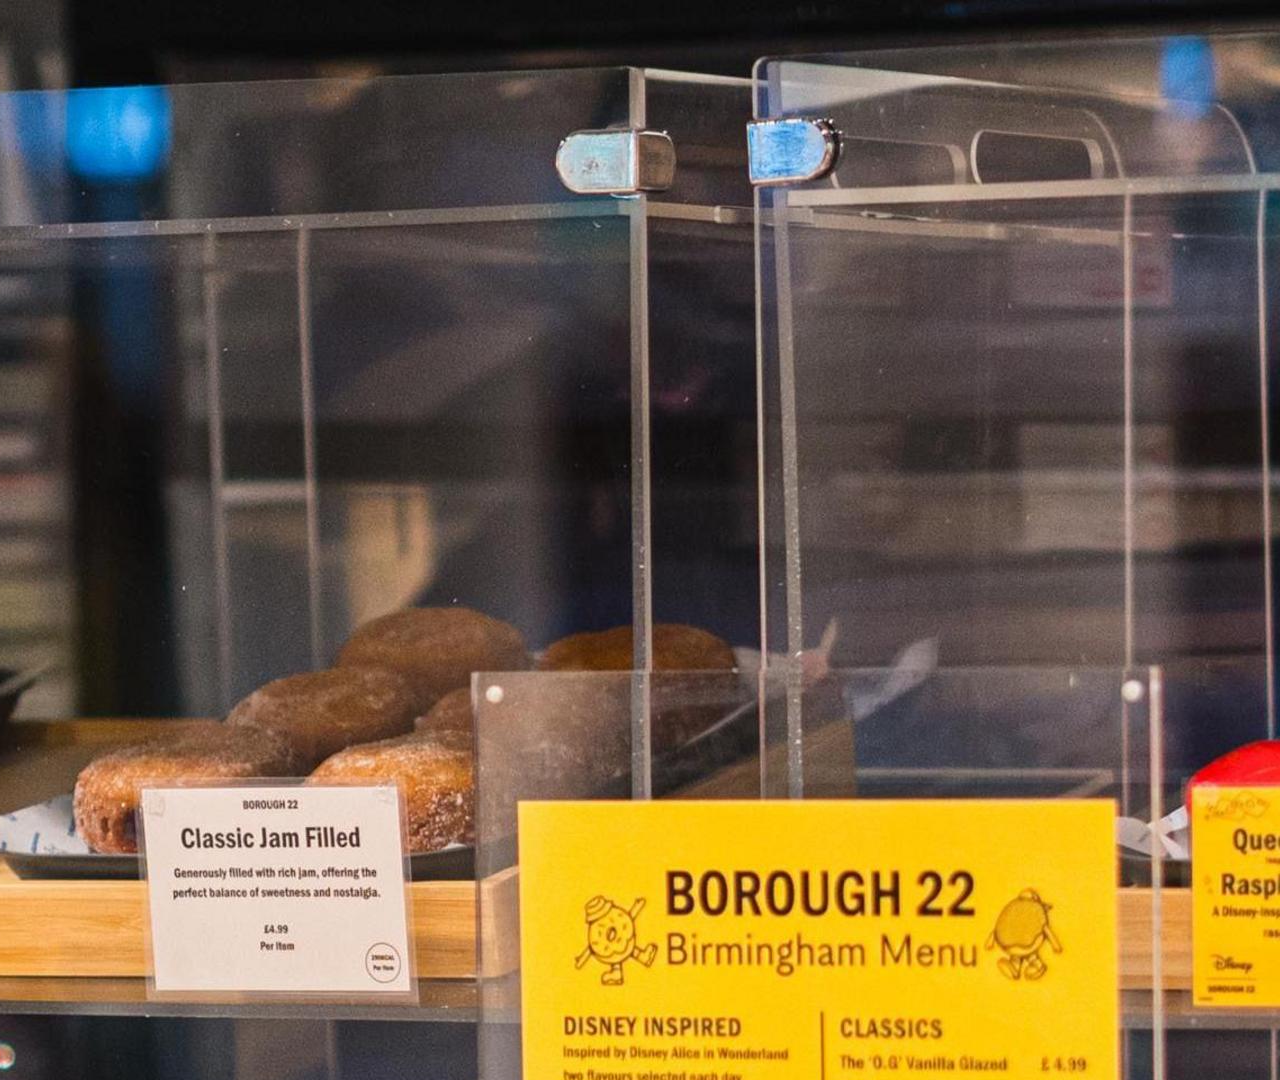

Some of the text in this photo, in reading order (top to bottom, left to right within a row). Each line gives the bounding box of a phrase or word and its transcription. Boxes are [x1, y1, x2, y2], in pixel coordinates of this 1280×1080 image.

[242, 799, 298, 809] BOROUGH 22
[180, 826, 360, 848] Classic Jam Filled
[173, 866, 377, 880] Generously filled with rich jam, offering the
[172, 886, 380, 900] perfect balance of sweetness and nostalgia.
[665, 870, 974, 916] BOROUGH 22
[263, 924, 288, 933] £4.99
[259, 941, 295, 950] Per Item
[666, 931, 978, 976] Birmingham Menu
[563, 1016, 741, 1037] DISNEY INSPIRED
[840, 1017, 942, 1039] CLASSICS
[840, 1054, 864, 1069] The
[906, 1056, 955, 1070] Vanilla
[958, 1056, 1008, 1071] Glazed
